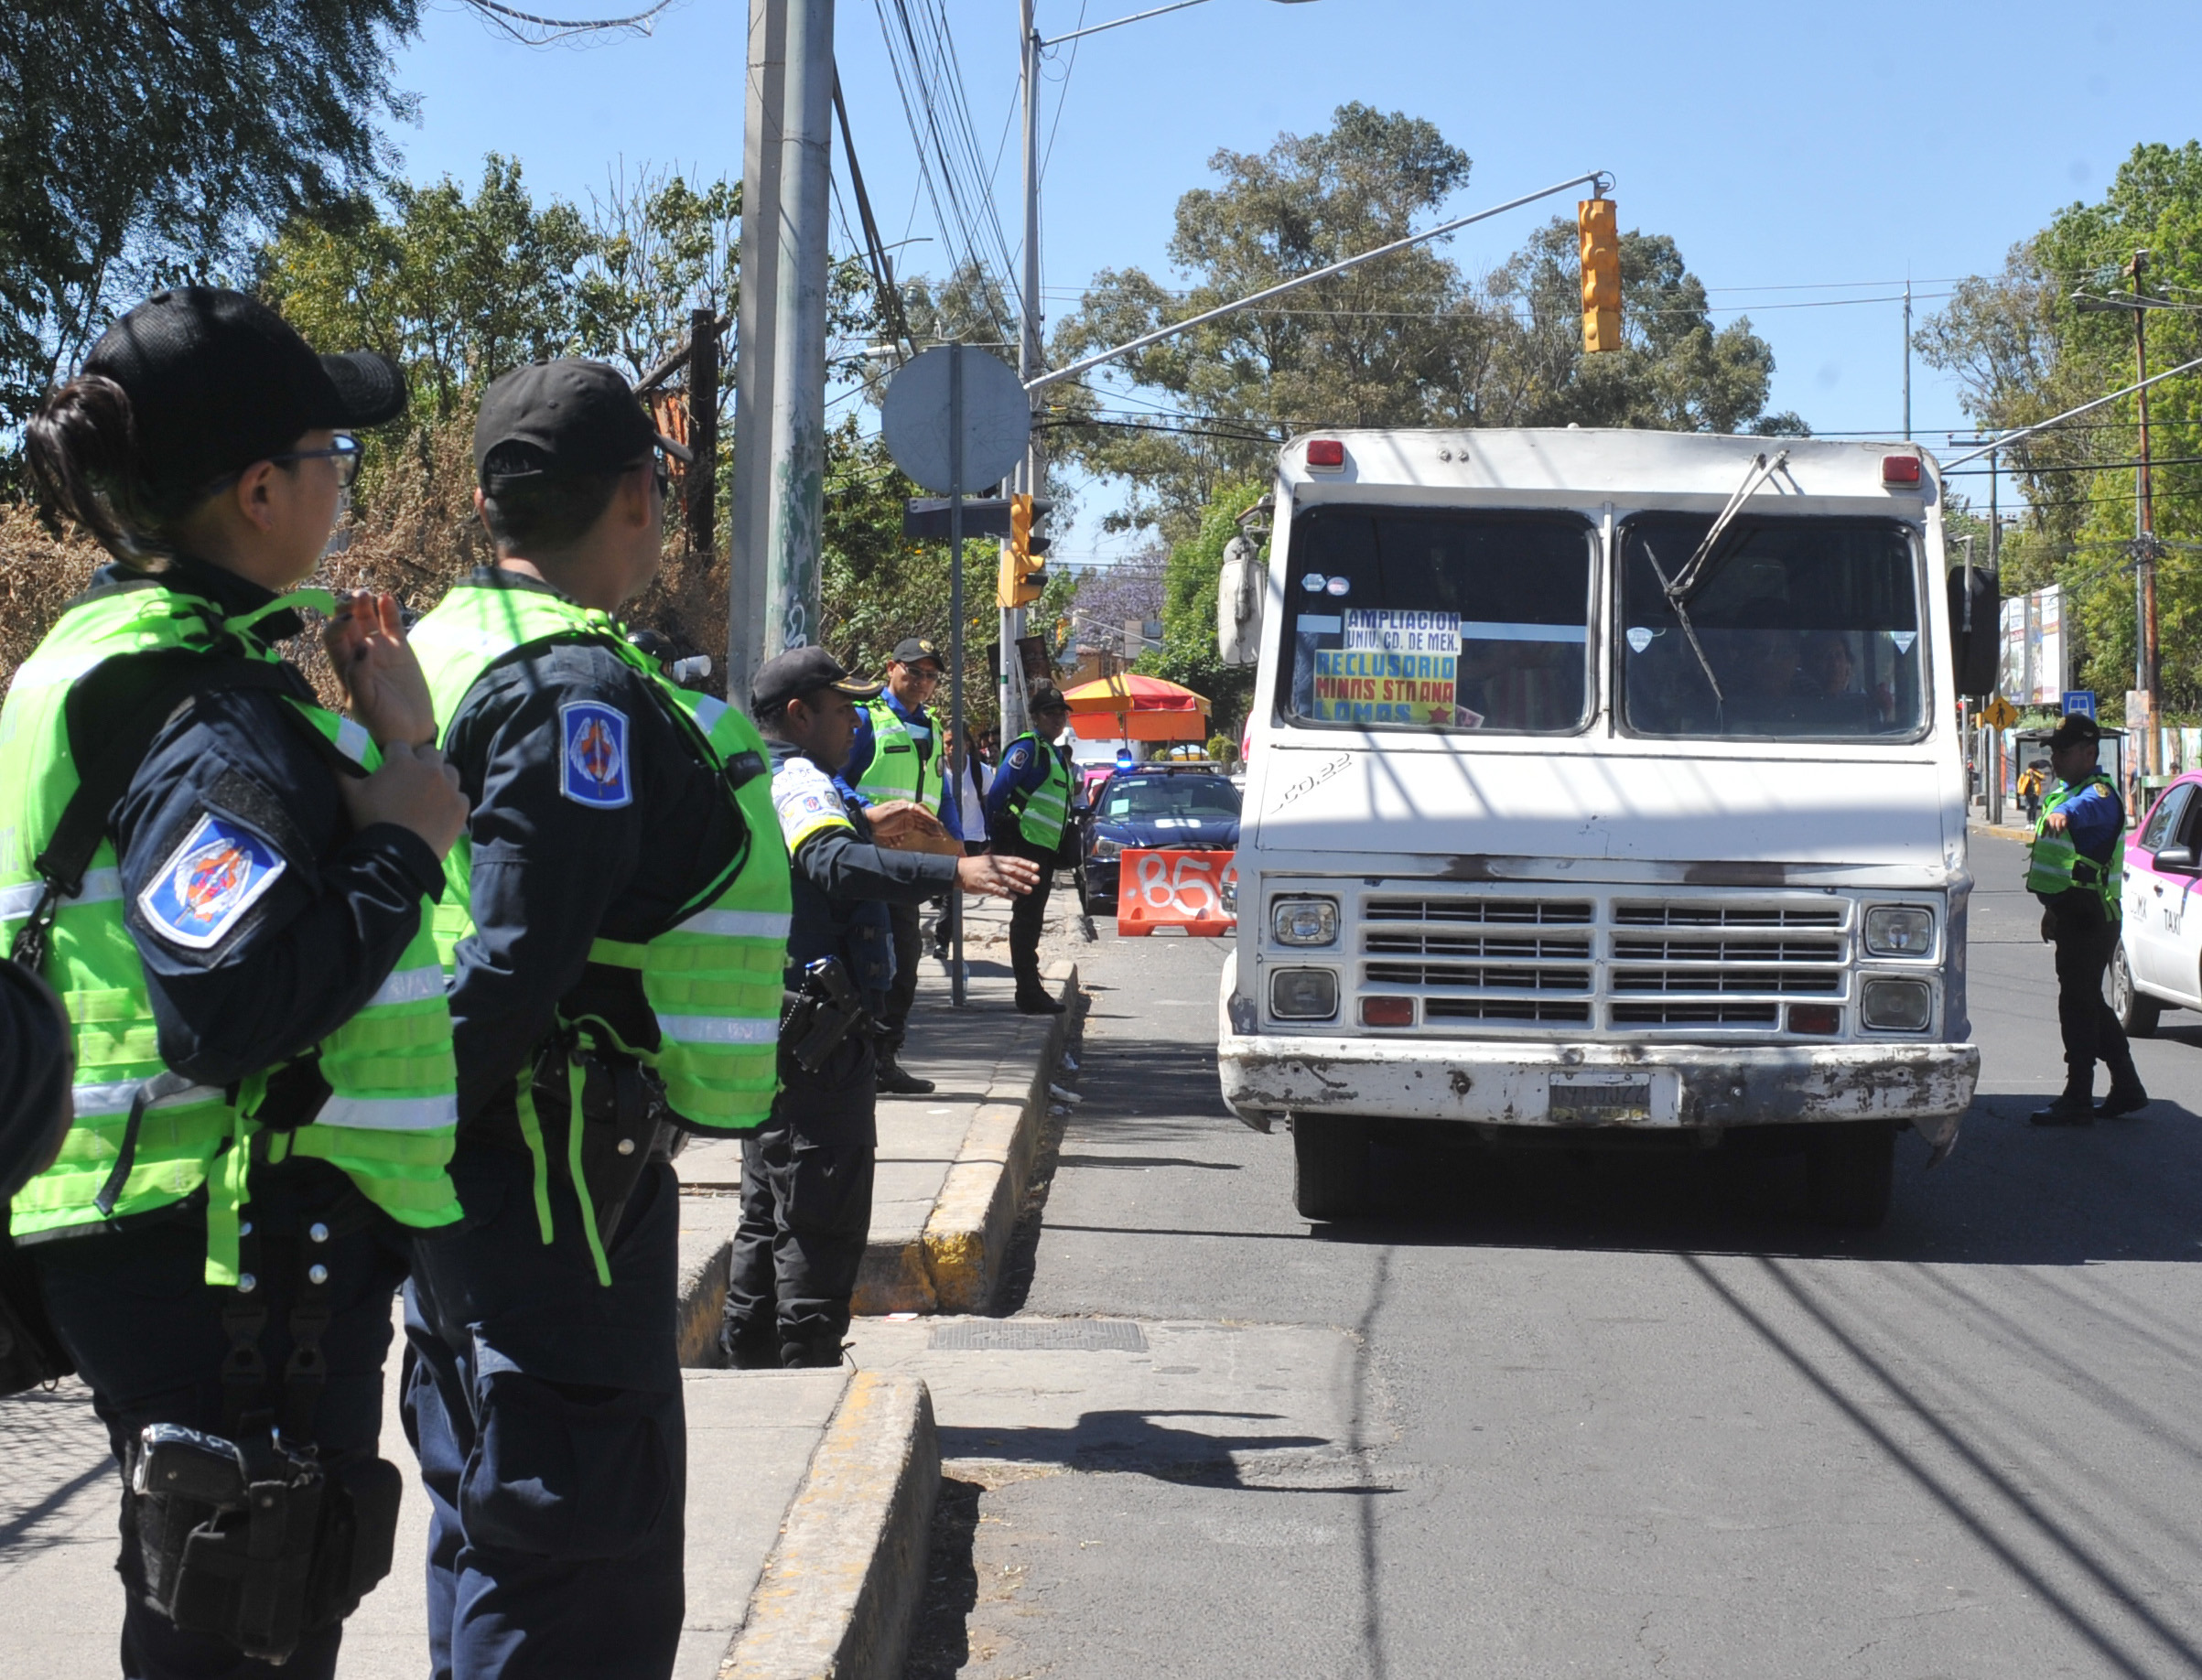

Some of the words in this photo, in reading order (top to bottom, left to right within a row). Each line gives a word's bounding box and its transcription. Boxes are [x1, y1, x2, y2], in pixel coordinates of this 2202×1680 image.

[1348, 609, 1460, 631] AMPLIACION
[1347, 630, 1379, 648] UNIV.
[1384, 631, 1403, 650] CD.
[1409, 632, 1423, 651] DE
[1428, 633, 1458, 652] MEX.
[1316, 651, 1454, 679] RECLUSORIO
[1316, 677, 1376, 700] MINAS
[1314, 700, 1411, 723] LOMAS
[2164, 908, 2181, 936] TAXI
